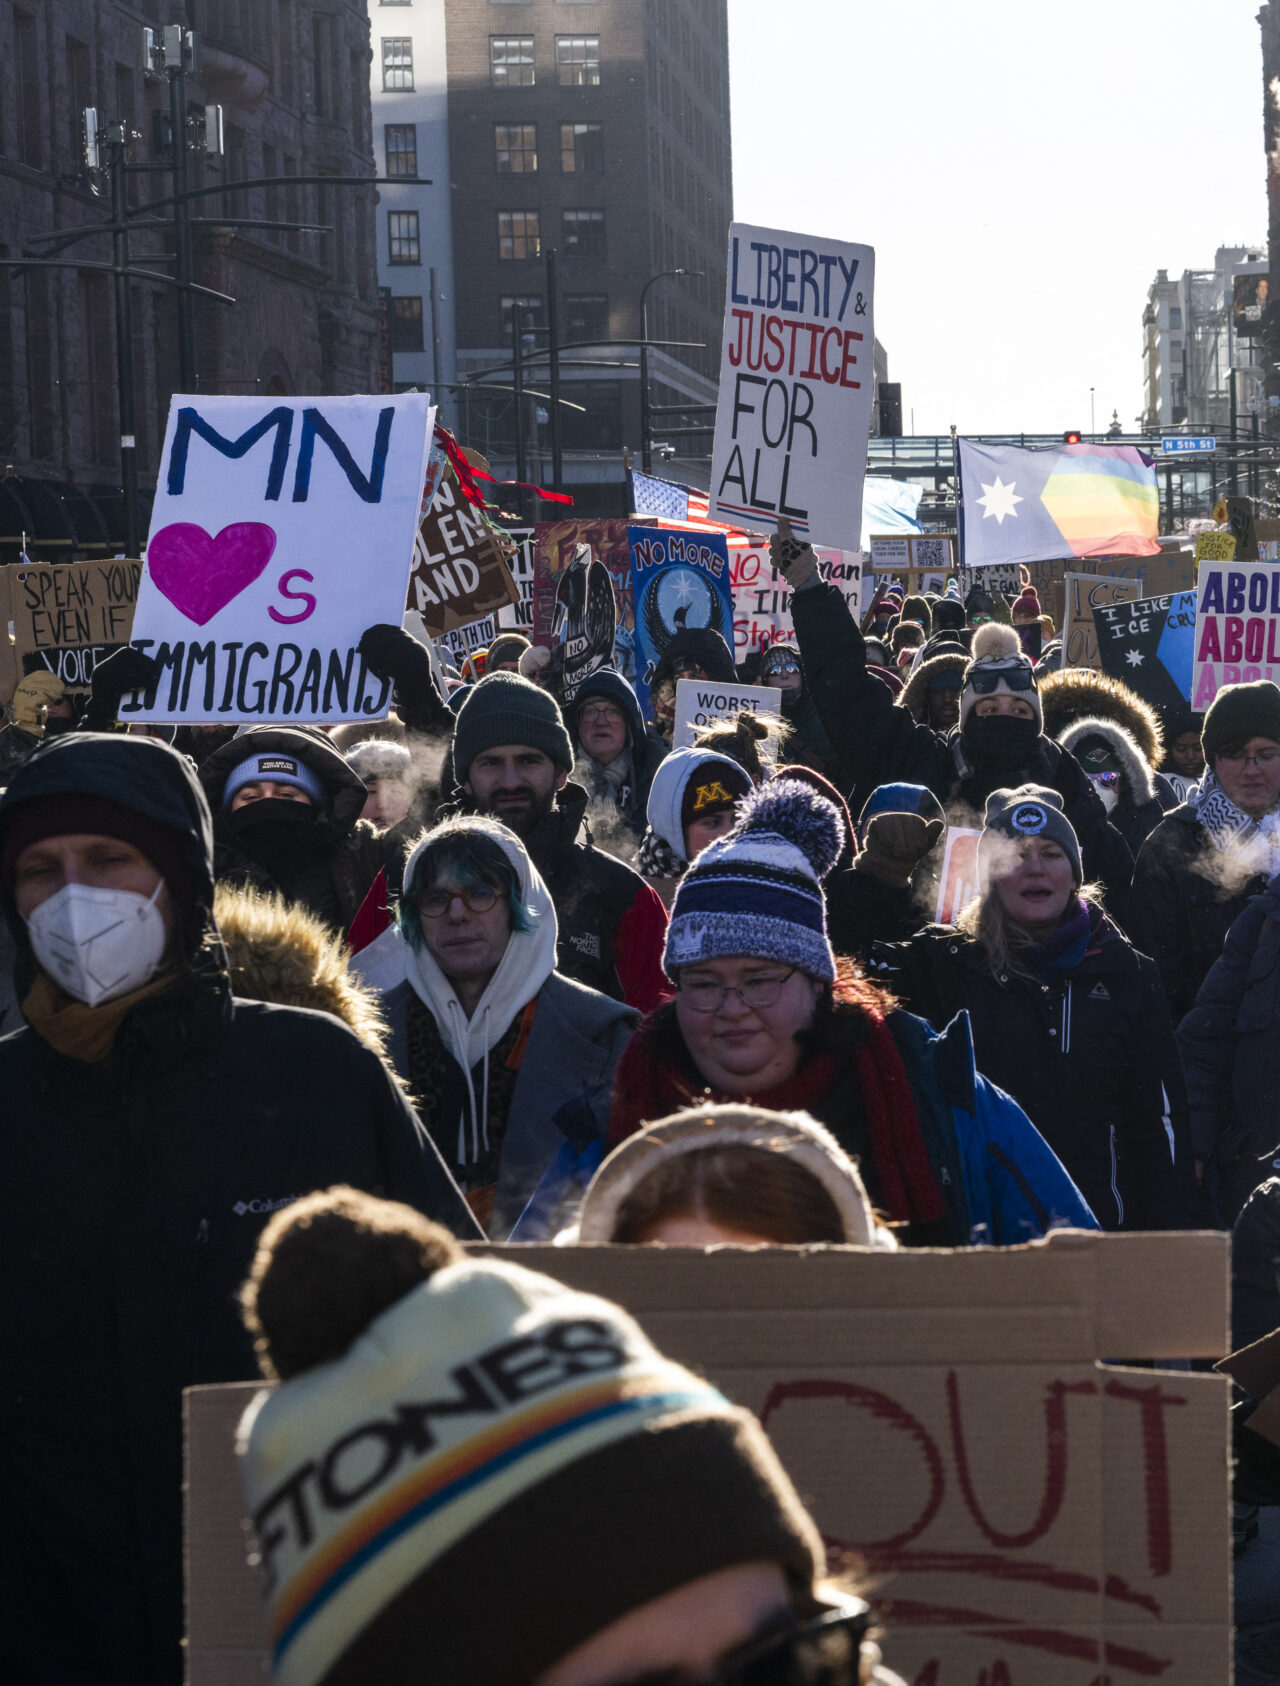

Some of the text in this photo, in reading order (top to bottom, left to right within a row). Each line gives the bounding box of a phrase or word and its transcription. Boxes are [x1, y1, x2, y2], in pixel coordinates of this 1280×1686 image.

[731, 237, 867, 322] LIBERTY &
[728, 308, 864, 389] JUSTICE
[731, 372, 818, 458] FOR
[167, 407, 395, 503] MN
[1165, 440, 1211, 449] N 5th St
[718, 444, 809, 520] ALL
[632, 538, 666, 572] NO
[668, 536, 725, 578] MORE
[1200, 532, 1236, 549] JUSTICE
[1200, 548, 1228, 559] GOOD
[24, 570, 94, 609] SPEAK
[267, 569, 317, 625] S
[414, 558, 480, 611] AND
[32, 605, 128, 647] EVEN IF
[1101, 608, 1120, 622] I
[1130, 597, 1169, 617] LIKE
[1111, 610, 1197, 639] ICE CRU
[478, 620, 494, 641] TO
[569, 641, 584, 655] NO
[1068, 629, 1098, 664] OU
[569, 661, 594, 683] MORE
[697, 692, 760, 712] WORST
[251, 1318, 632, 1596] FTONES
[760, 1369, 1188, 1578] OUT
